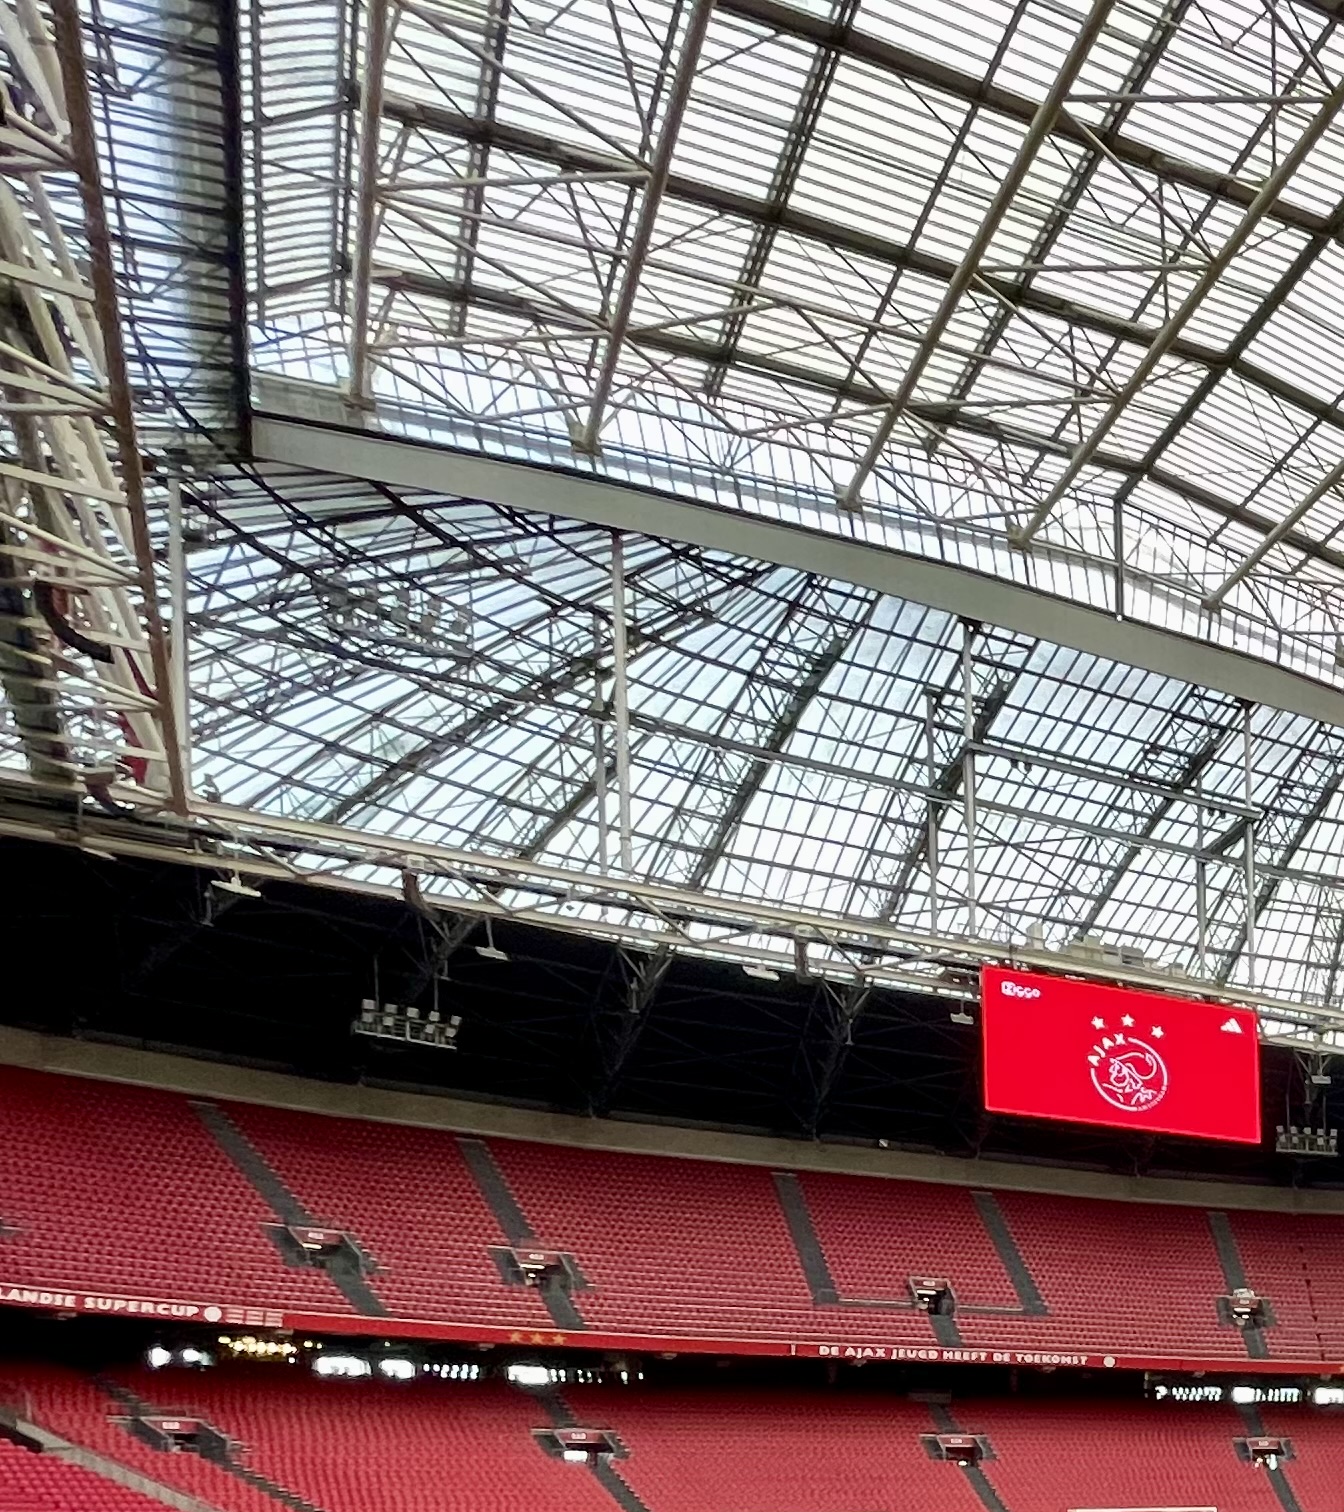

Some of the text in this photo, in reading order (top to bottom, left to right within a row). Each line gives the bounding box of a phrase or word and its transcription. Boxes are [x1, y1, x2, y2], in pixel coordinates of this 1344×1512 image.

[1087, 1032, 1127, 1067] AJAX
[84, 1297, 200, 1318] SUPERCUP
[818, 1345, 840, 1357] DE
[844, 1346, 886, 1359] AJAX
[891, 1348, 938, 1361] JEUGD
[943, 1350, 987, 1362] HEEFT
[992, 1352, 1011, 1363] DE
